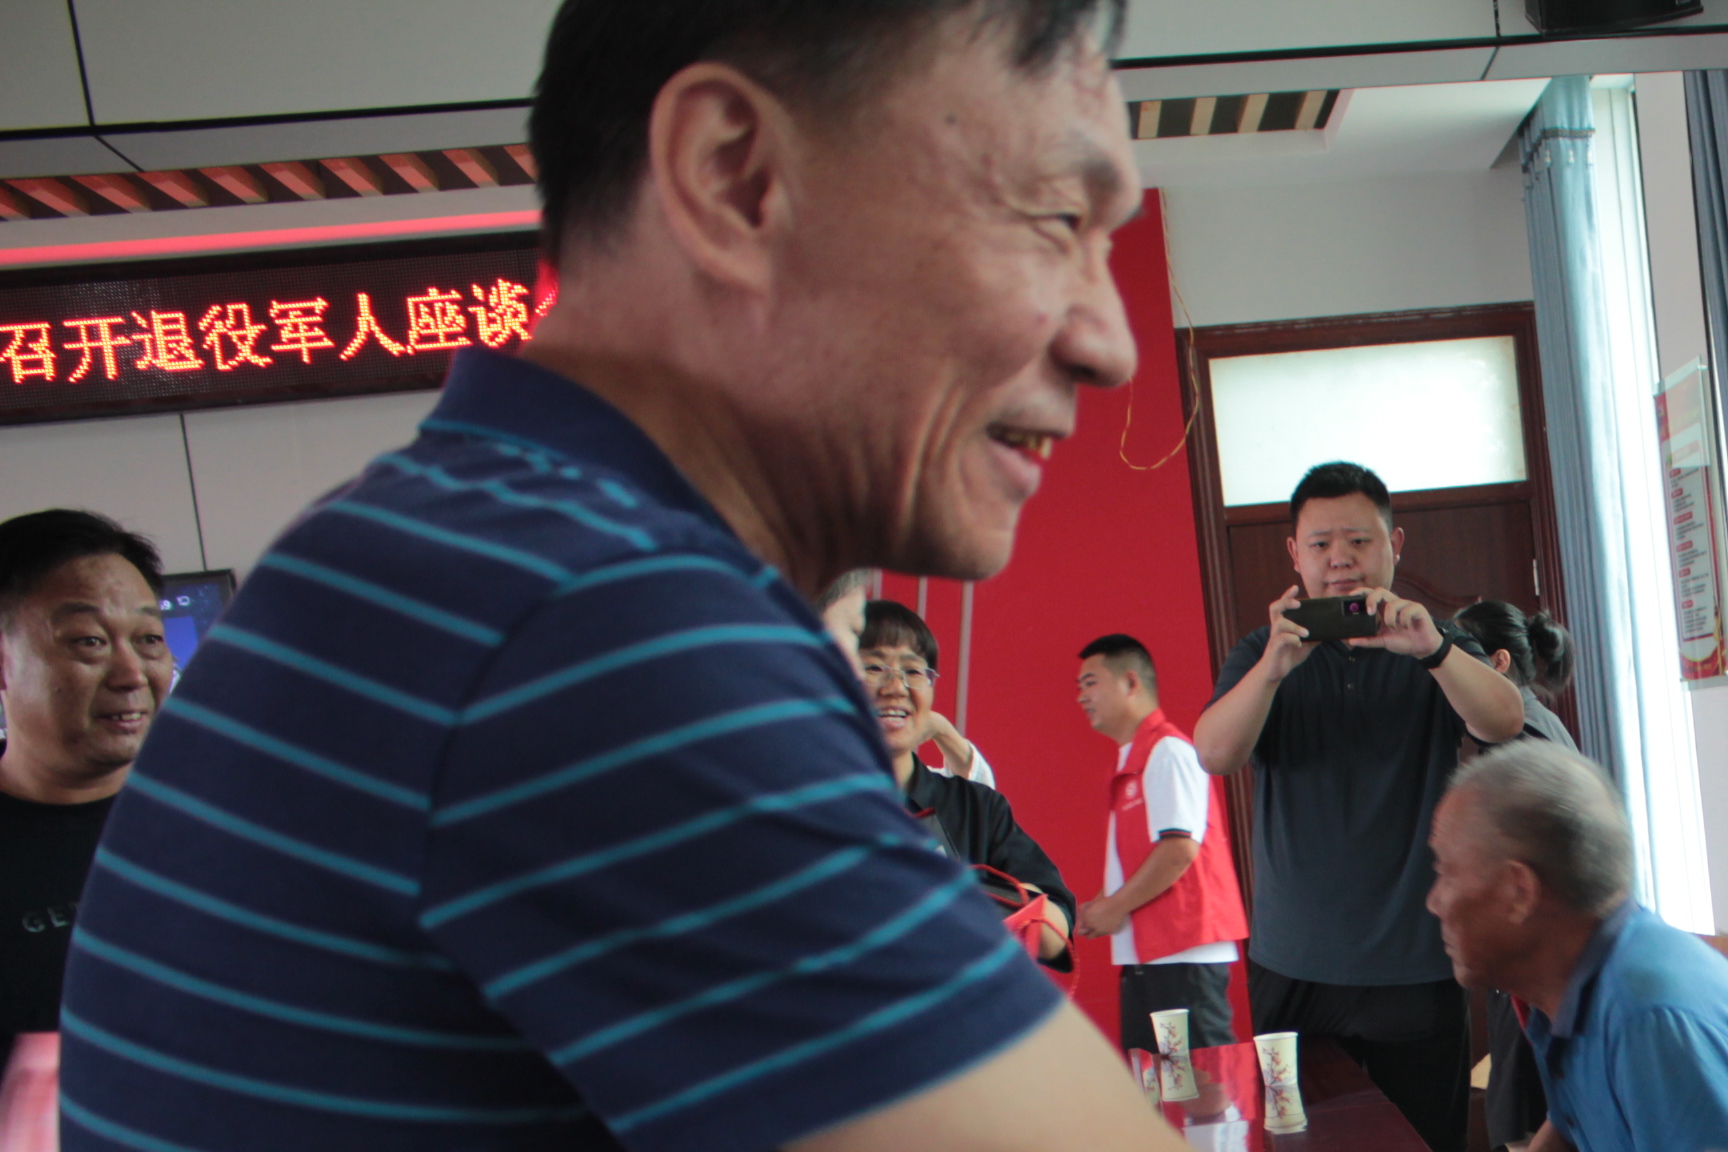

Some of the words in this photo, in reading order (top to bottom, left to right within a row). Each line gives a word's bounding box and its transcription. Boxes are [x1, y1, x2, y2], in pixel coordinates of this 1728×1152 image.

[0, 278, 558, 384] 召开退役军人座谈
